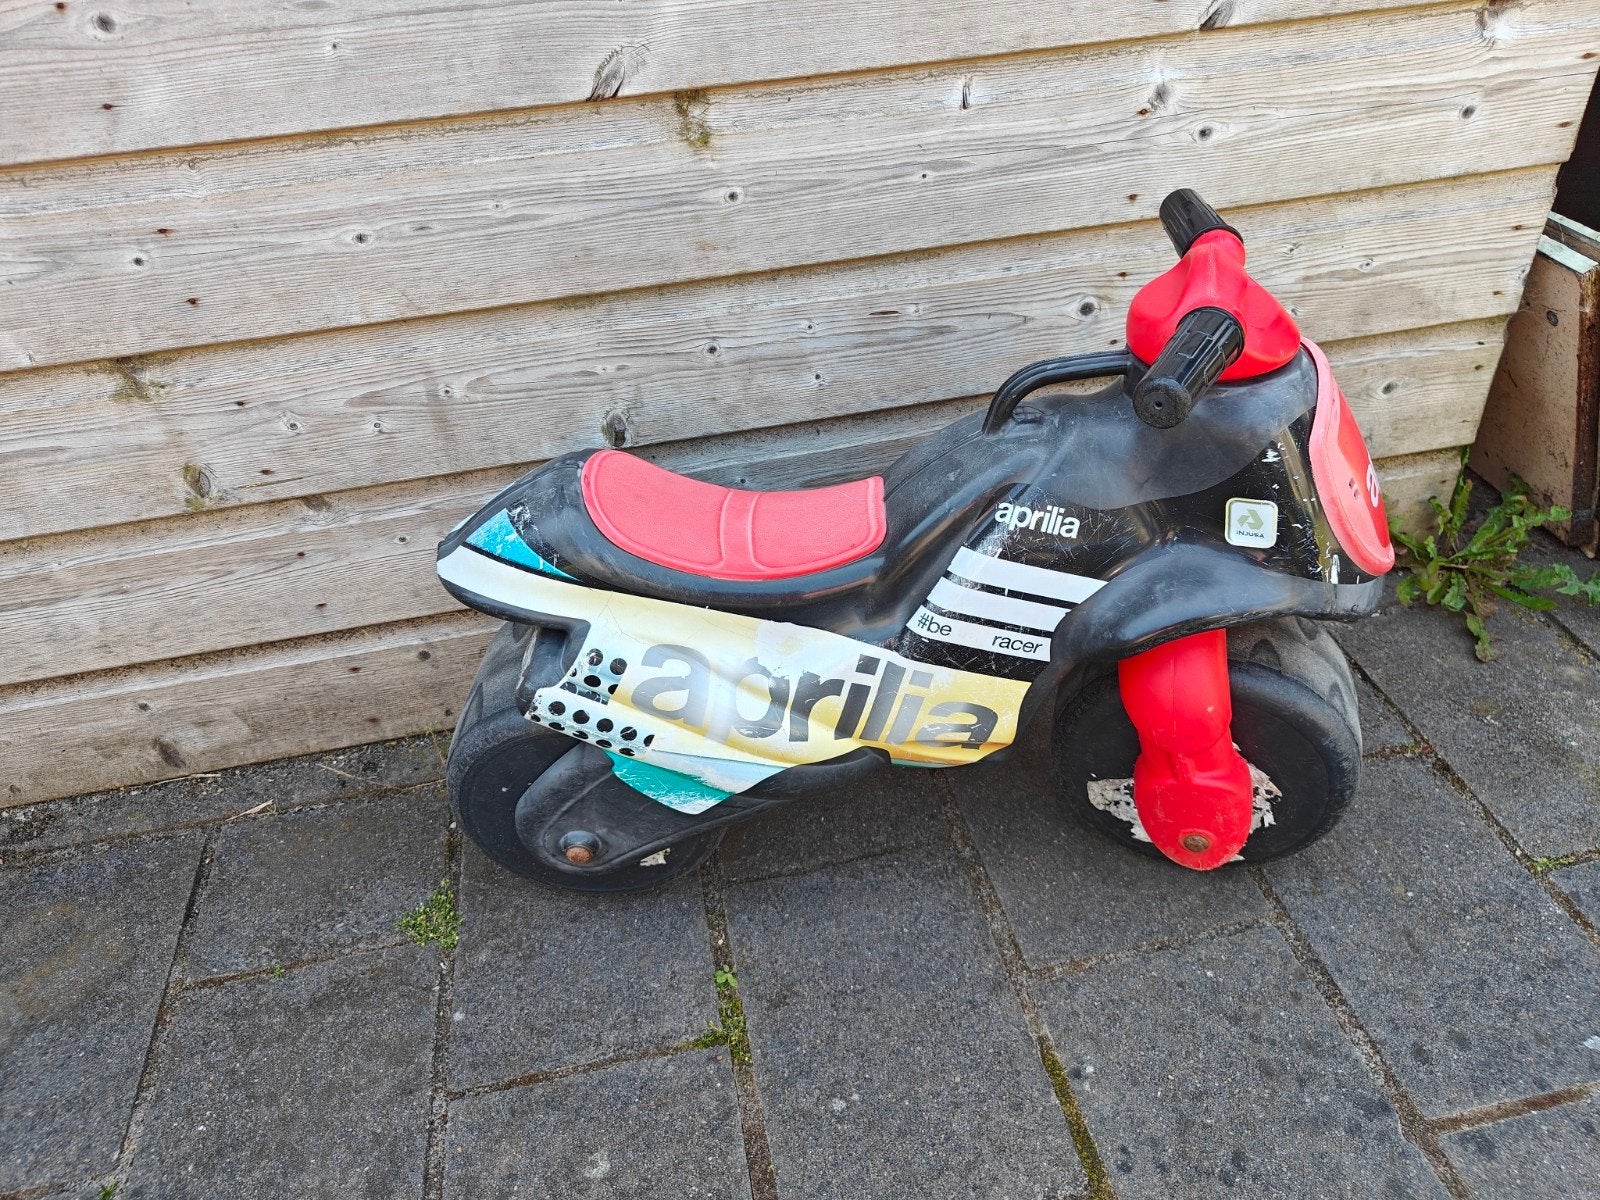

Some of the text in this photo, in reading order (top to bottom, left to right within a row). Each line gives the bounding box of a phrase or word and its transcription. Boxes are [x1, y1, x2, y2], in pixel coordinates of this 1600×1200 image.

[994, 502, 1080, 539] aprilia
[917, 612, 1043, 654] #be racer
[630, 643, 999, 750] aprilia
